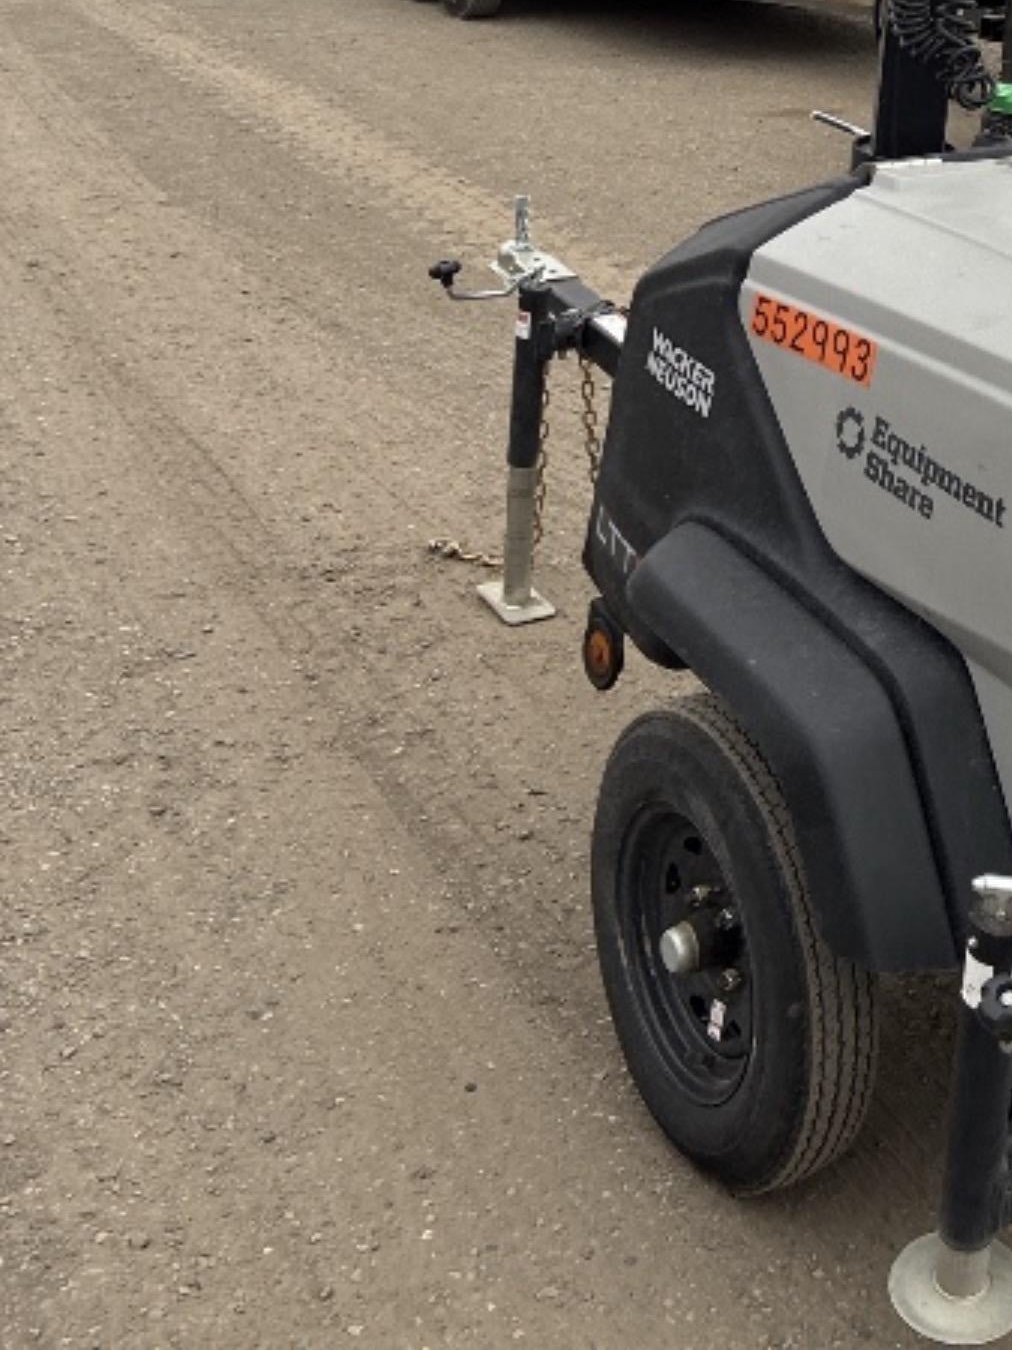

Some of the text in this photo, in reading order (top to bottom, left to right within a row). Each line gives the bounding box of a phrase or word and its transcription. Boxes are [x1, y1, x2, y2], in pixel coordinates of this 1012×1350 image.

[652, 326, 715, 397] WACKER
[752, 295, 871, 382] 552993
[644, 350, 712, 419] NEUSON
[863, 449, 934, 520] Share
[870, 414, 1007, 529] Equipment
